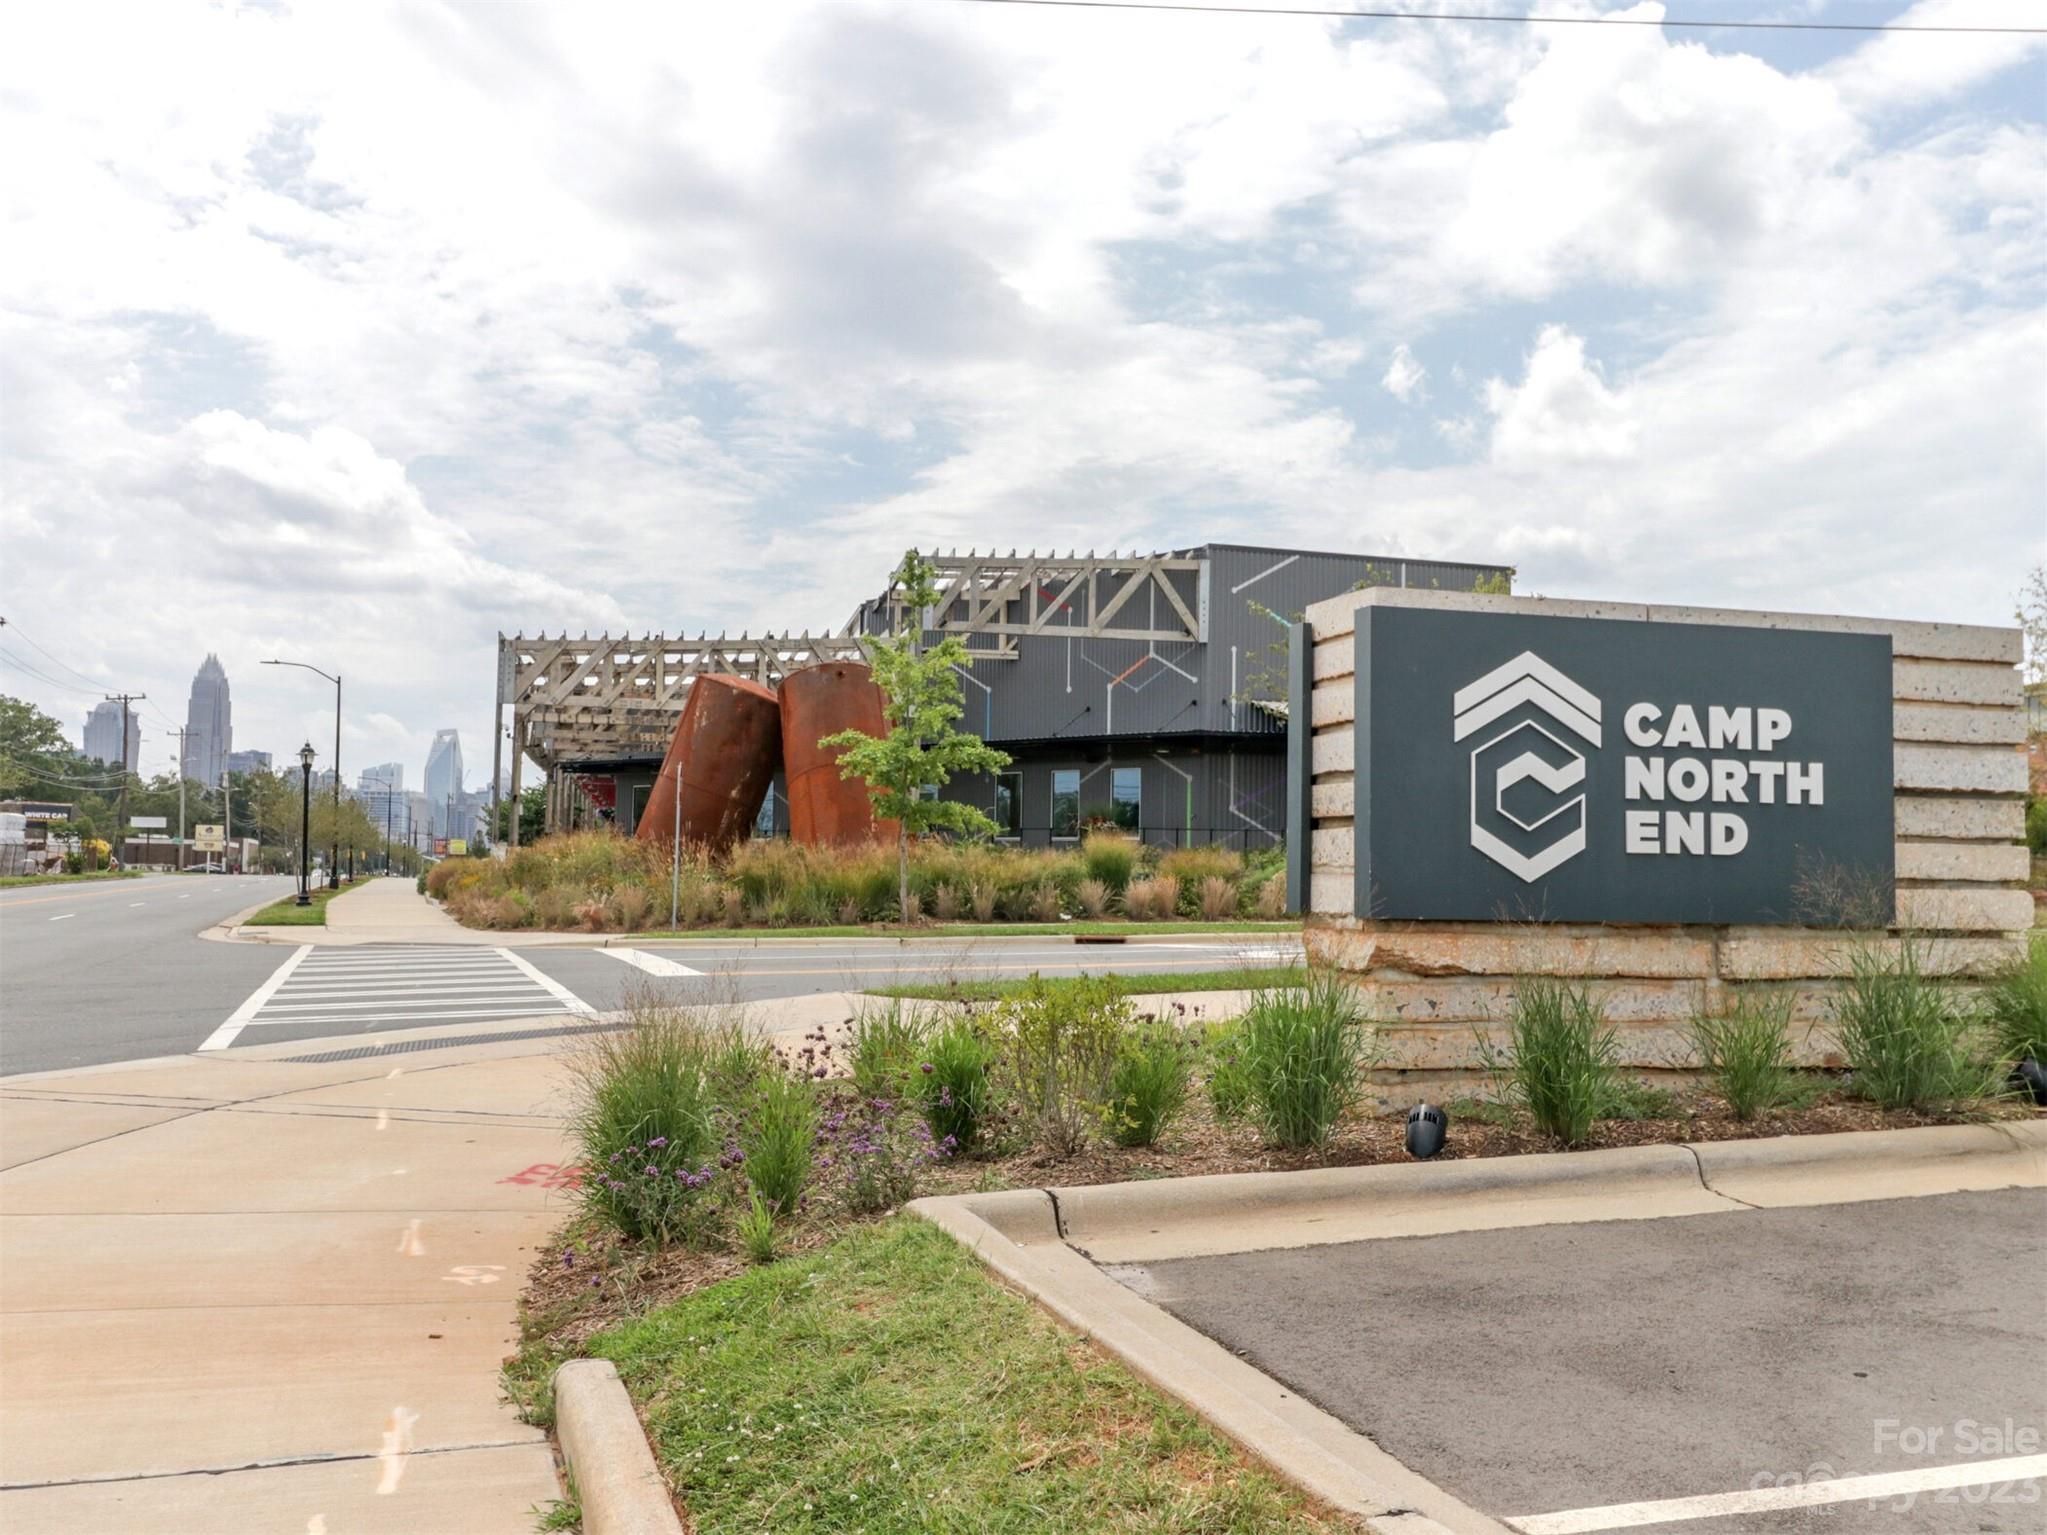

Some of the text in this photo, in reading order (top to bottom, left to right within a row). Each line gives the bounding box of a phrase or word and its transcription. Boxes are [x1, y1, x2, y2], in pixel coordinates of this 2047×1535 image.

[1623, 702, 1792, 751] CAMP
[1625, 756, 1824, 805] NORTH
[24, 811, 50, 819] WHITE
[1625, 810, 1749, 856] END
